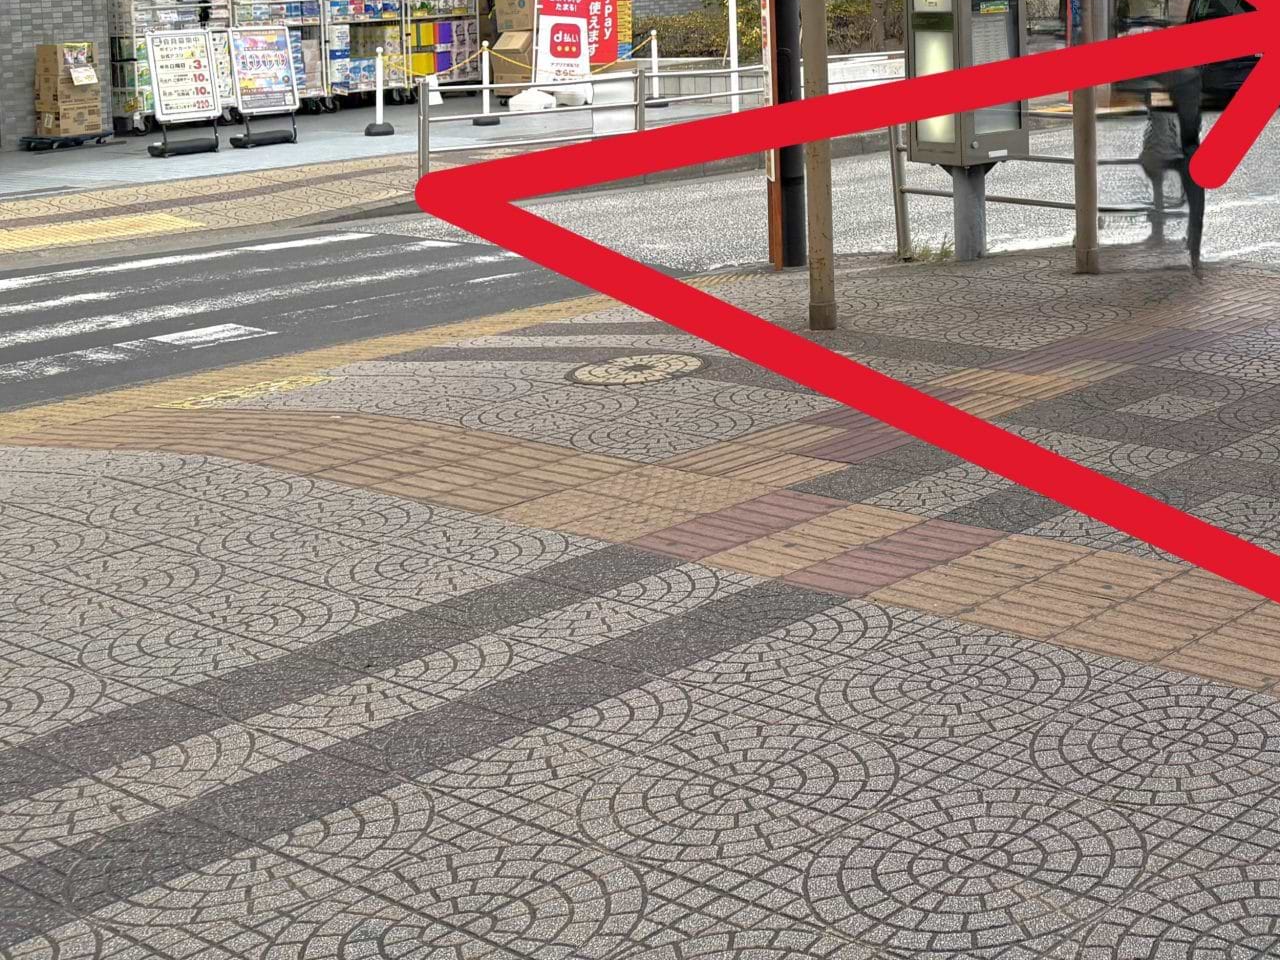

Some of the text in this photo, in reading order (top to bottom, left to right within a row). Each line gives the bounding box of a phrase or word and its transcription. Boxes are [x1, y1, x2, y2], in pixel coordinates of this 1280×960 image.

[553, 29, 579, 43] d払い
[588, 0, 602, 57] 使えます
